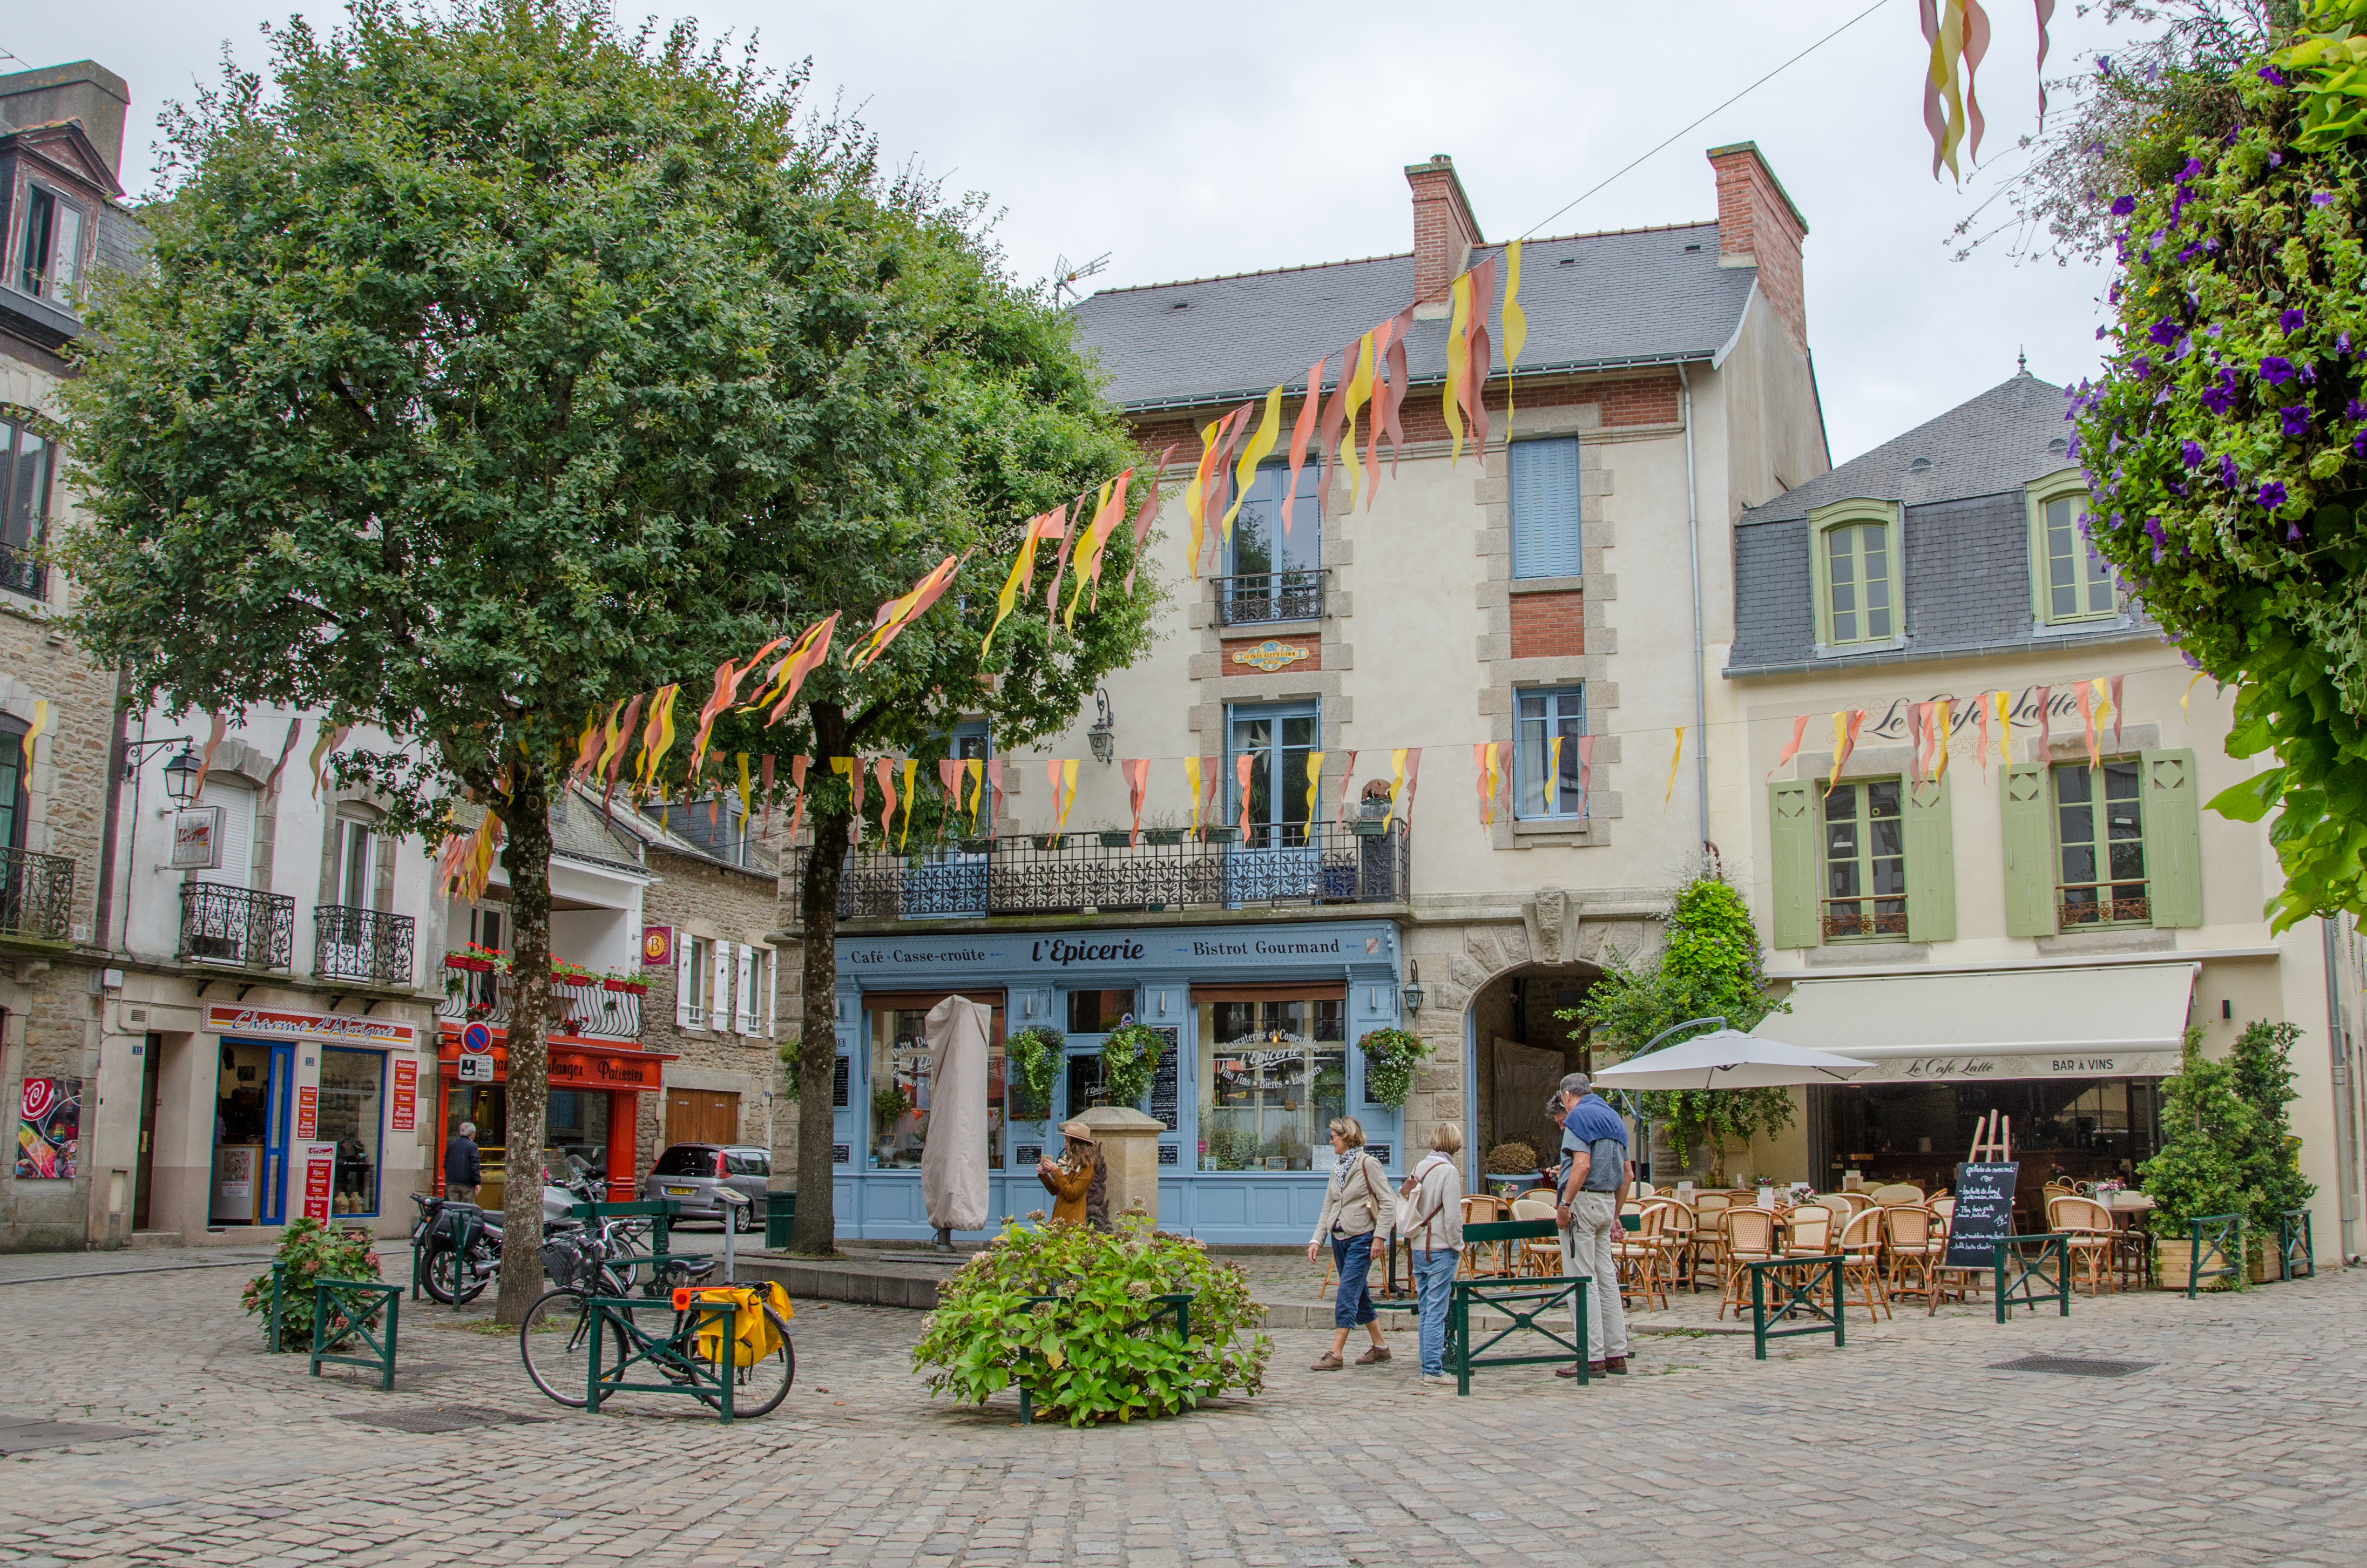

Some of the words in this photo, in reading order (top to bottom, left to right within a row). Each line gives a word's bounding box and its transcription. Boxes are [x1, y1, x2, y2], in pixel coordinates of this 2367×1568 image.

[1864, 698, 1910, 740] Le
[651, 938, 659, 951] B
[1032, 938, 1145, 965] l'Epicerie
[1193, 941, 1248, 956] Bistrot
[1255, 939, 1340, 955] Gourmand
[851, 950, 884, 963] Café
[894, 949, 985, 962] Casse-croûte
[232, 1010, 309, 1032] Charme
[313, 1016, 395, 1043] d'Afrique
[891, 1040, 913, 1059] Petit
[1220, 1030, 1266, 1053] Charcuteries
[1269, 1029, 1276, 1039] et
[1280, 1029, 1322, 1053] Comestibles
[1240, 1045, 1300, 1066] l'Epicerie
[2053, 1060, 2074, 1070] BAR
[2088, 1059, 2113, 1070] VINS
[1220, 1061, 1235, 1080] Vins
[1237, 1073, 1251, 1086] fins
[1259, 1078, 1283, 1089] Bières
[1291, 1064, 1322, 1085] Liqueurs
[1903, 1058, 1923, 1077] Le
[1925, 1058, 1962, 1079] Café
[1958, 1057, 1994, 1076] Latté
